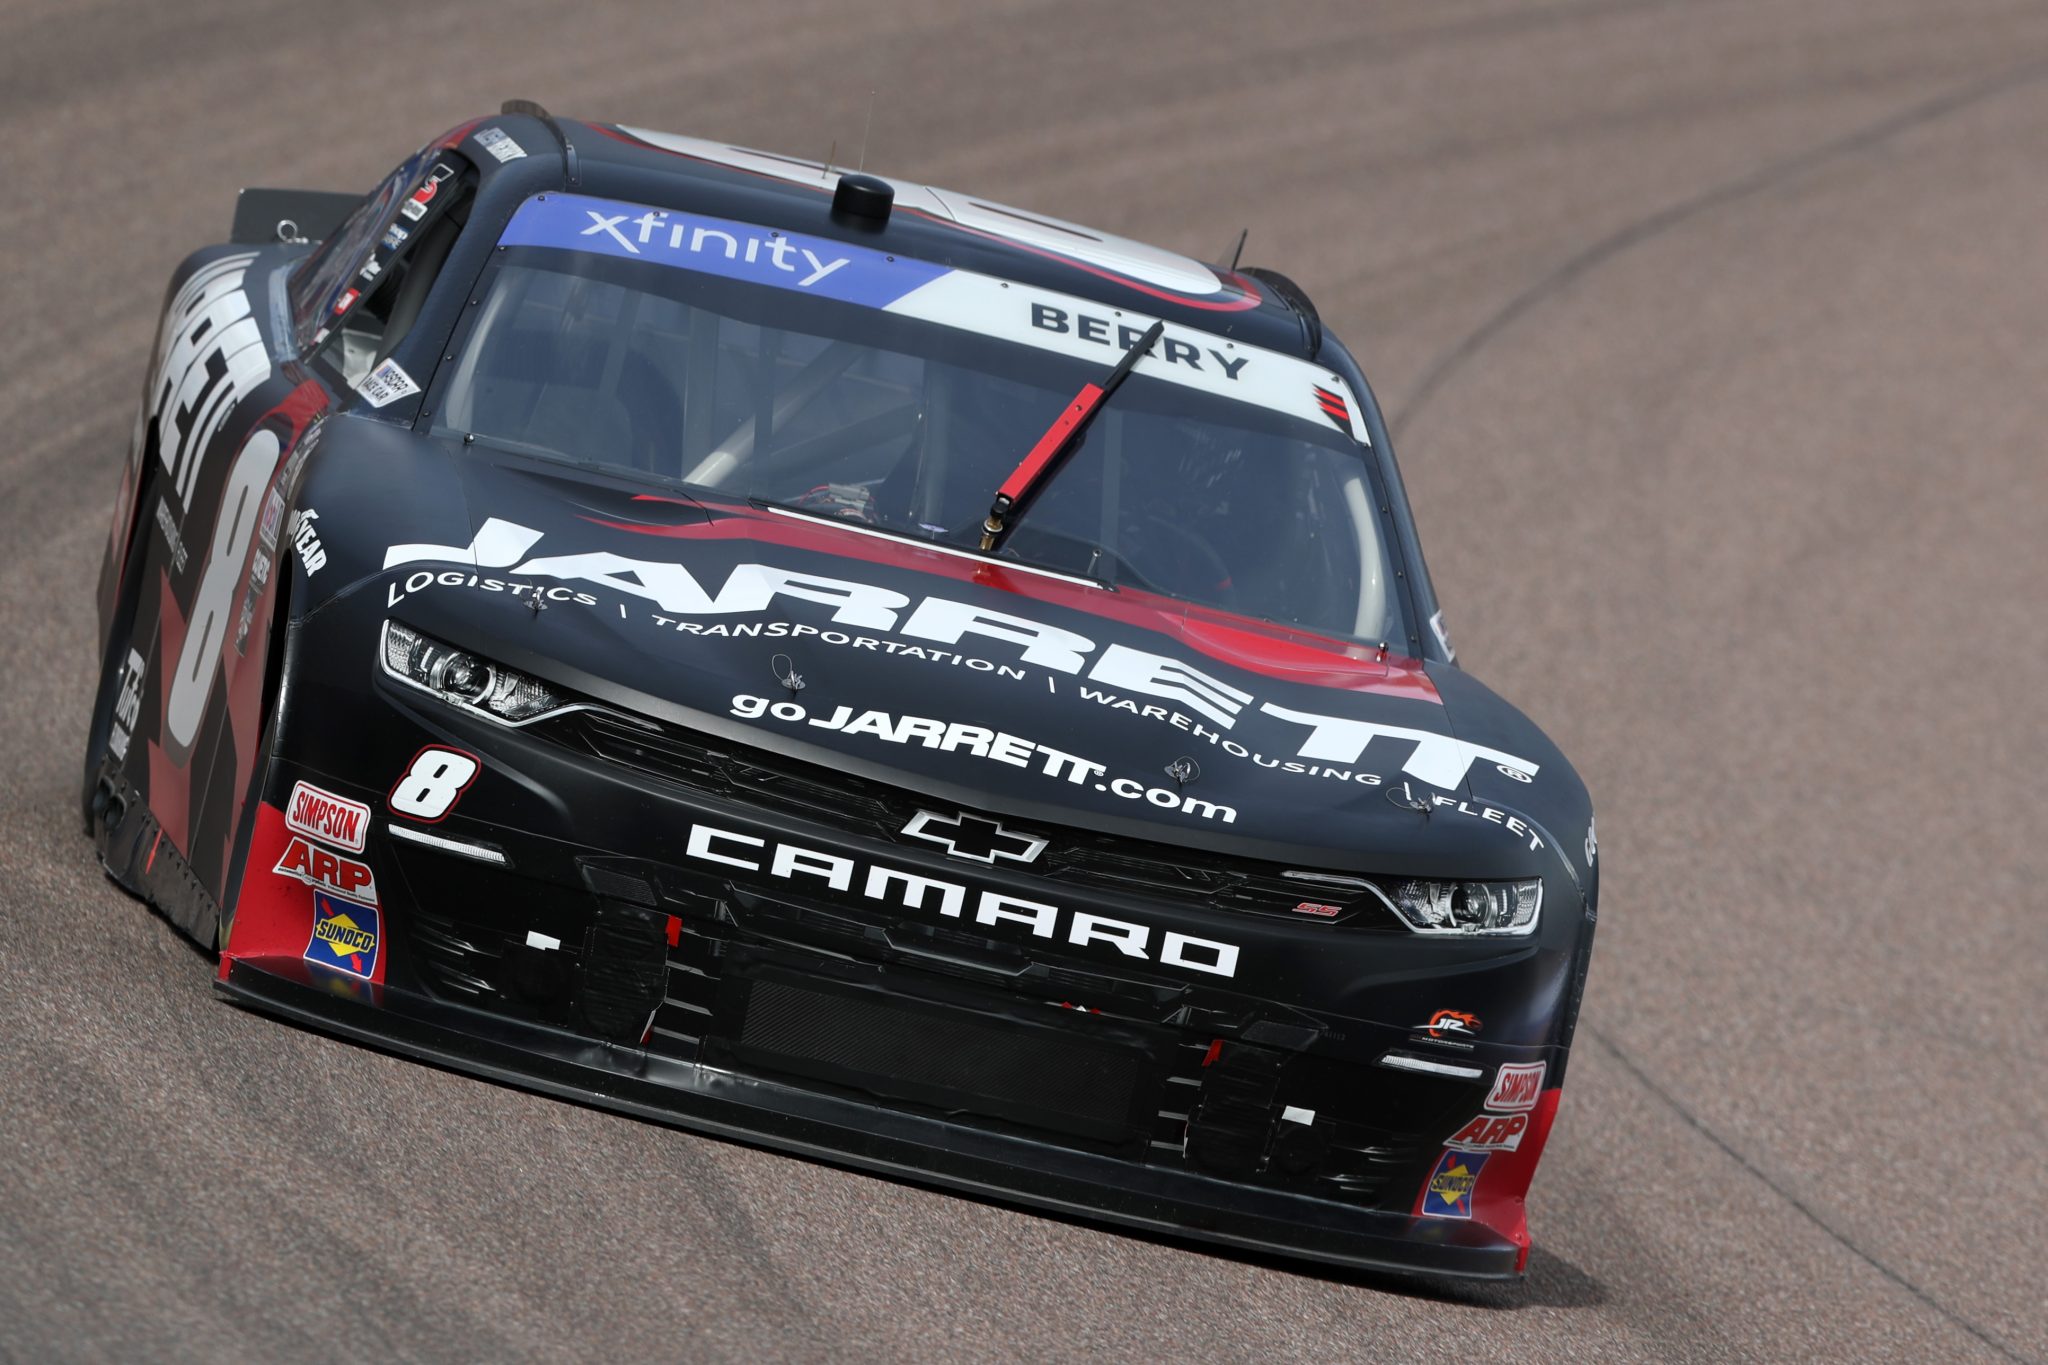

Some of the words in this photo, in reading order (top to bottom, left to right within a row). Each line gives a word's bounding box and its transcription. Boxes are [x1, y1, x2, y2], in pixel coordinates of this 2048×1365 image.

[580, 210, 851, 288] xfinity
[168, 429, 281, 747] 8
[384, 517, 1540, 791] JARRETT
[387, 571, 597, 608] LOGISTICS
[651, 614, 1026, 681] TRANSPORTATION
[1080, 686, 1383, 786] WAREHOUSING
[1431, 795, 1545, 852] FLEET
[389, 747, 480, 822] 8
[293, 791, 361, 844] SIMPSON
[280, 843, 372, 893] ARP
[686, 823, 1240, 978] CAMARO
[318, 921, 375, 951] SUNOCO
[1498, 1067, 1542, 1104] SIMPSON
[1454, 1116, 1526, 1144] ARP
[1431, 1174, 1474, 1193] SUNOCO
